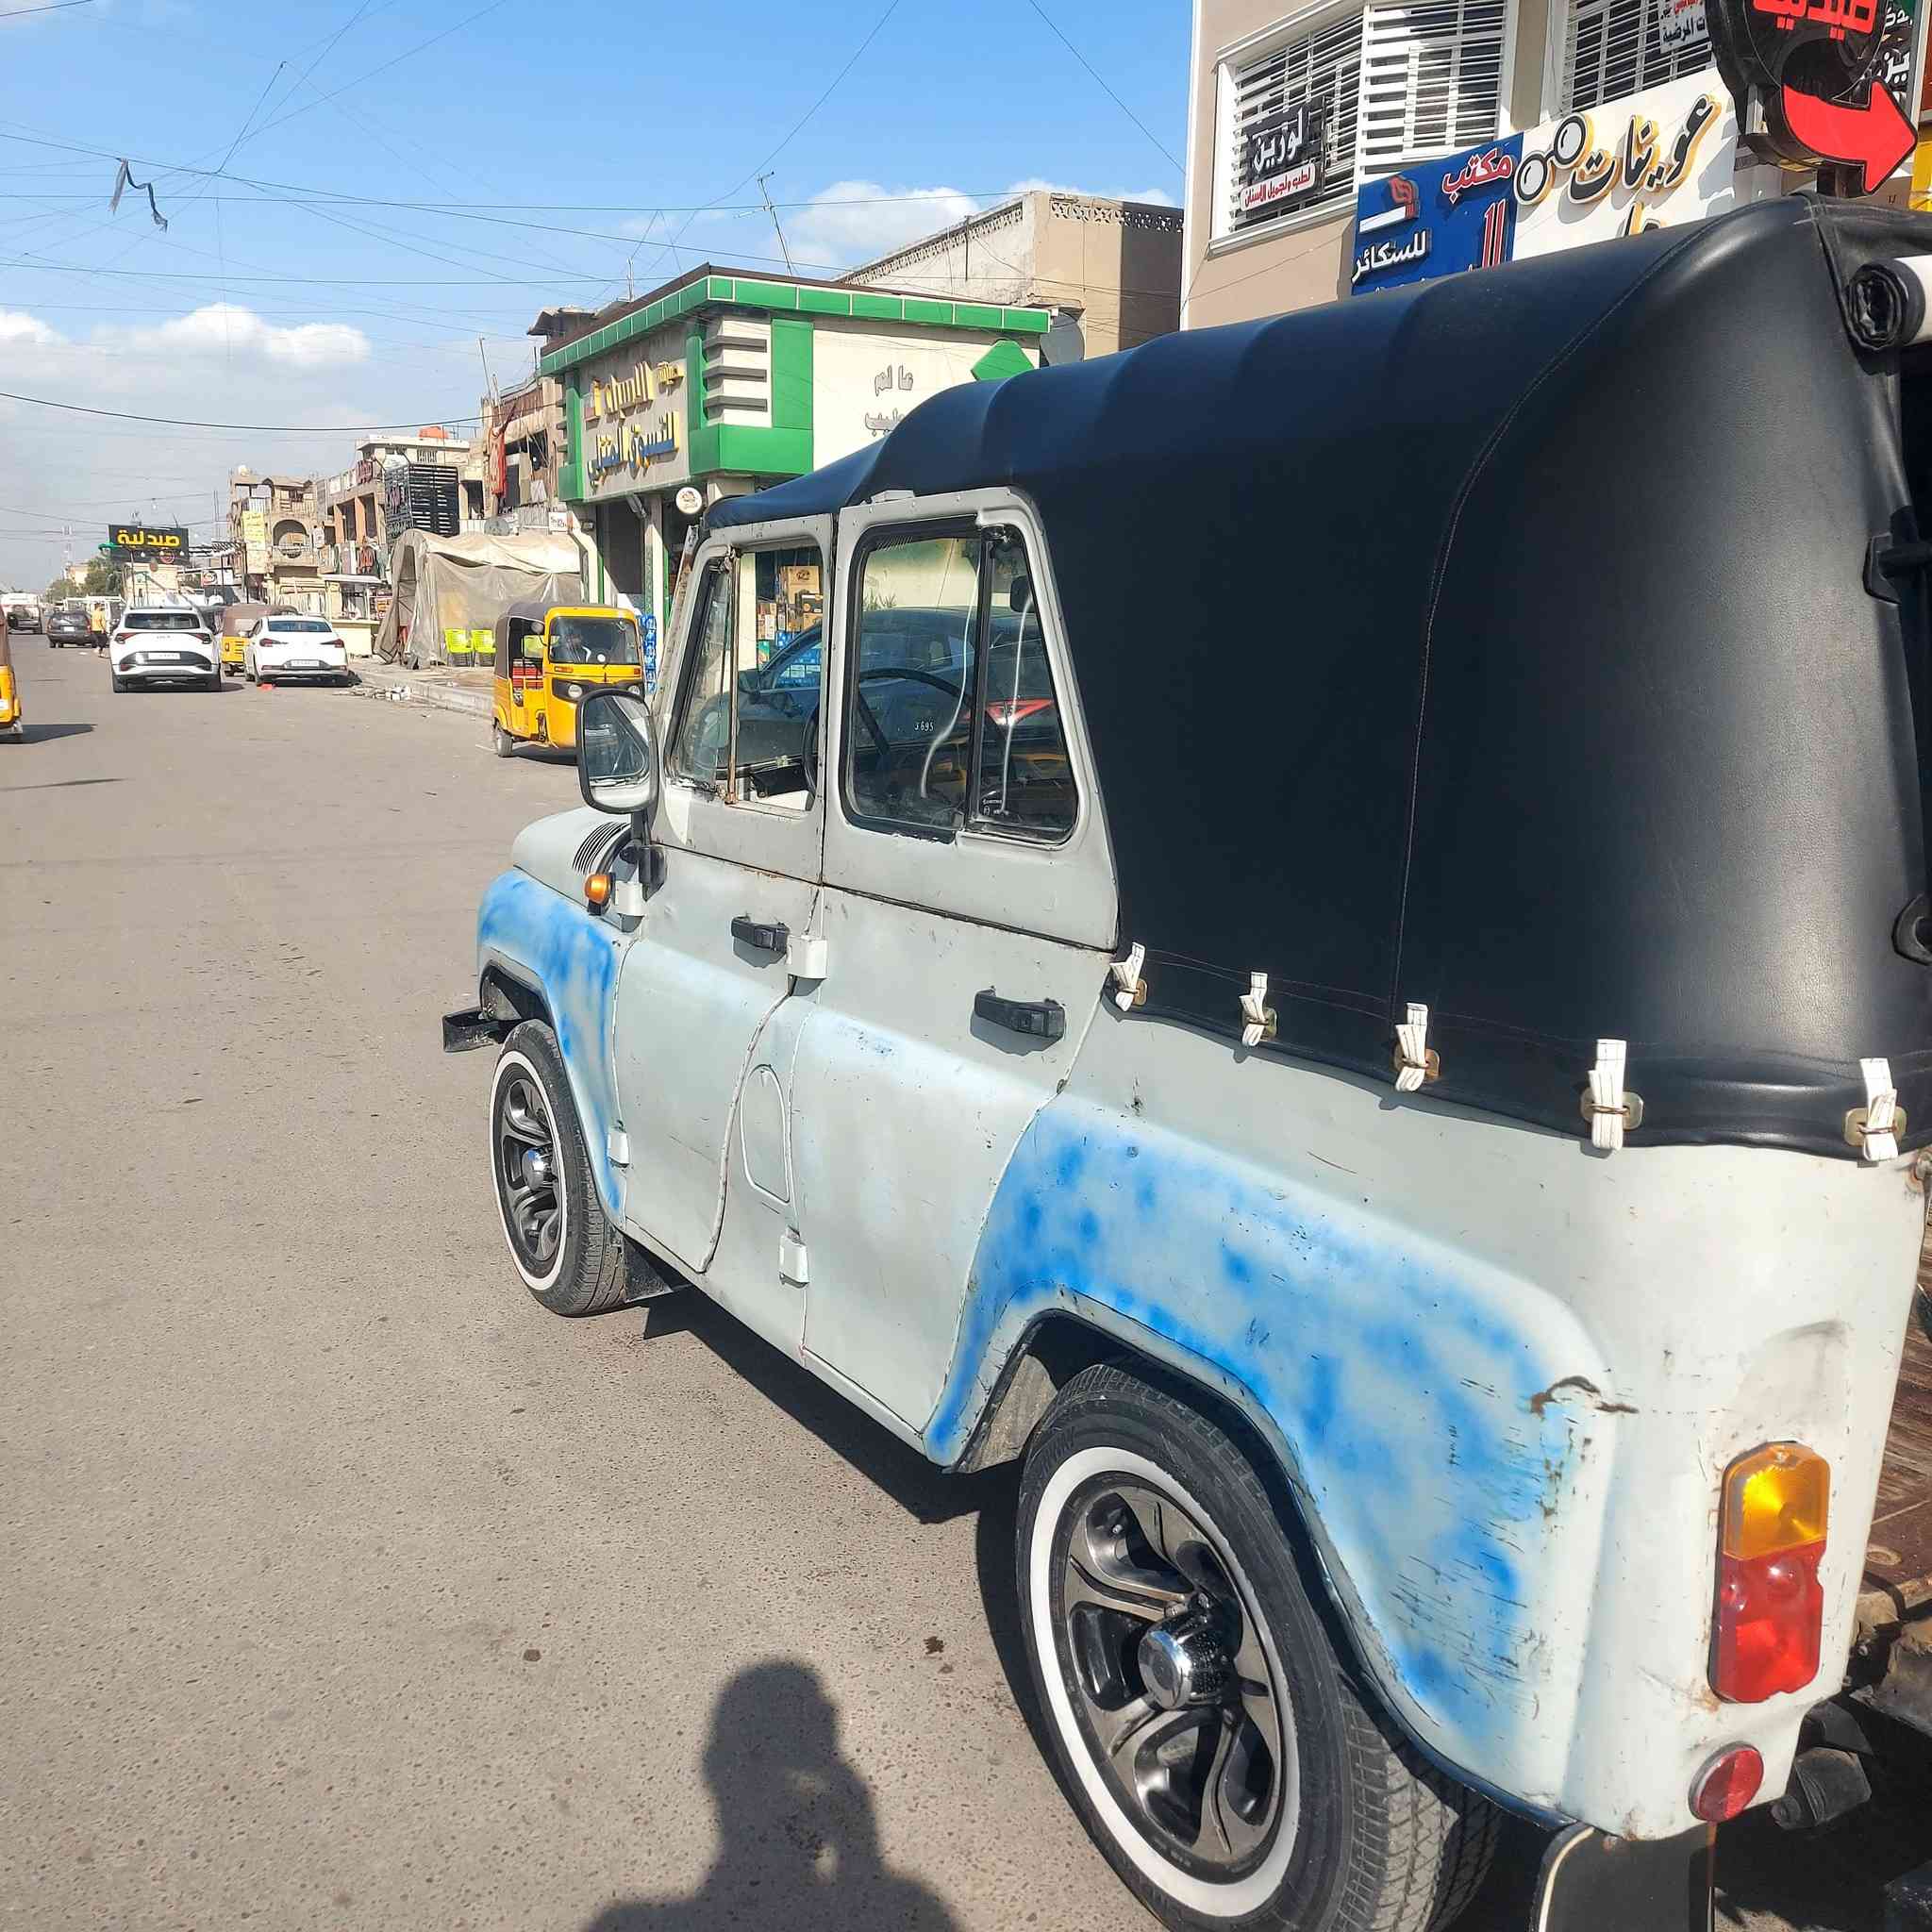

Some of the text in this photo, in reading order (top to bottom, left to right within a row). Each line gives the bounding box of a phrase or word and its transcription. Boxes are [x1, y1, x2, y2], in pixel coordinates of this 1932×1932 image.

[1441, 148, 1513, 204] مكتب
[1351, 230, 1427, 284] للسكائر
[117, 529, 181, 548] صيدلية
